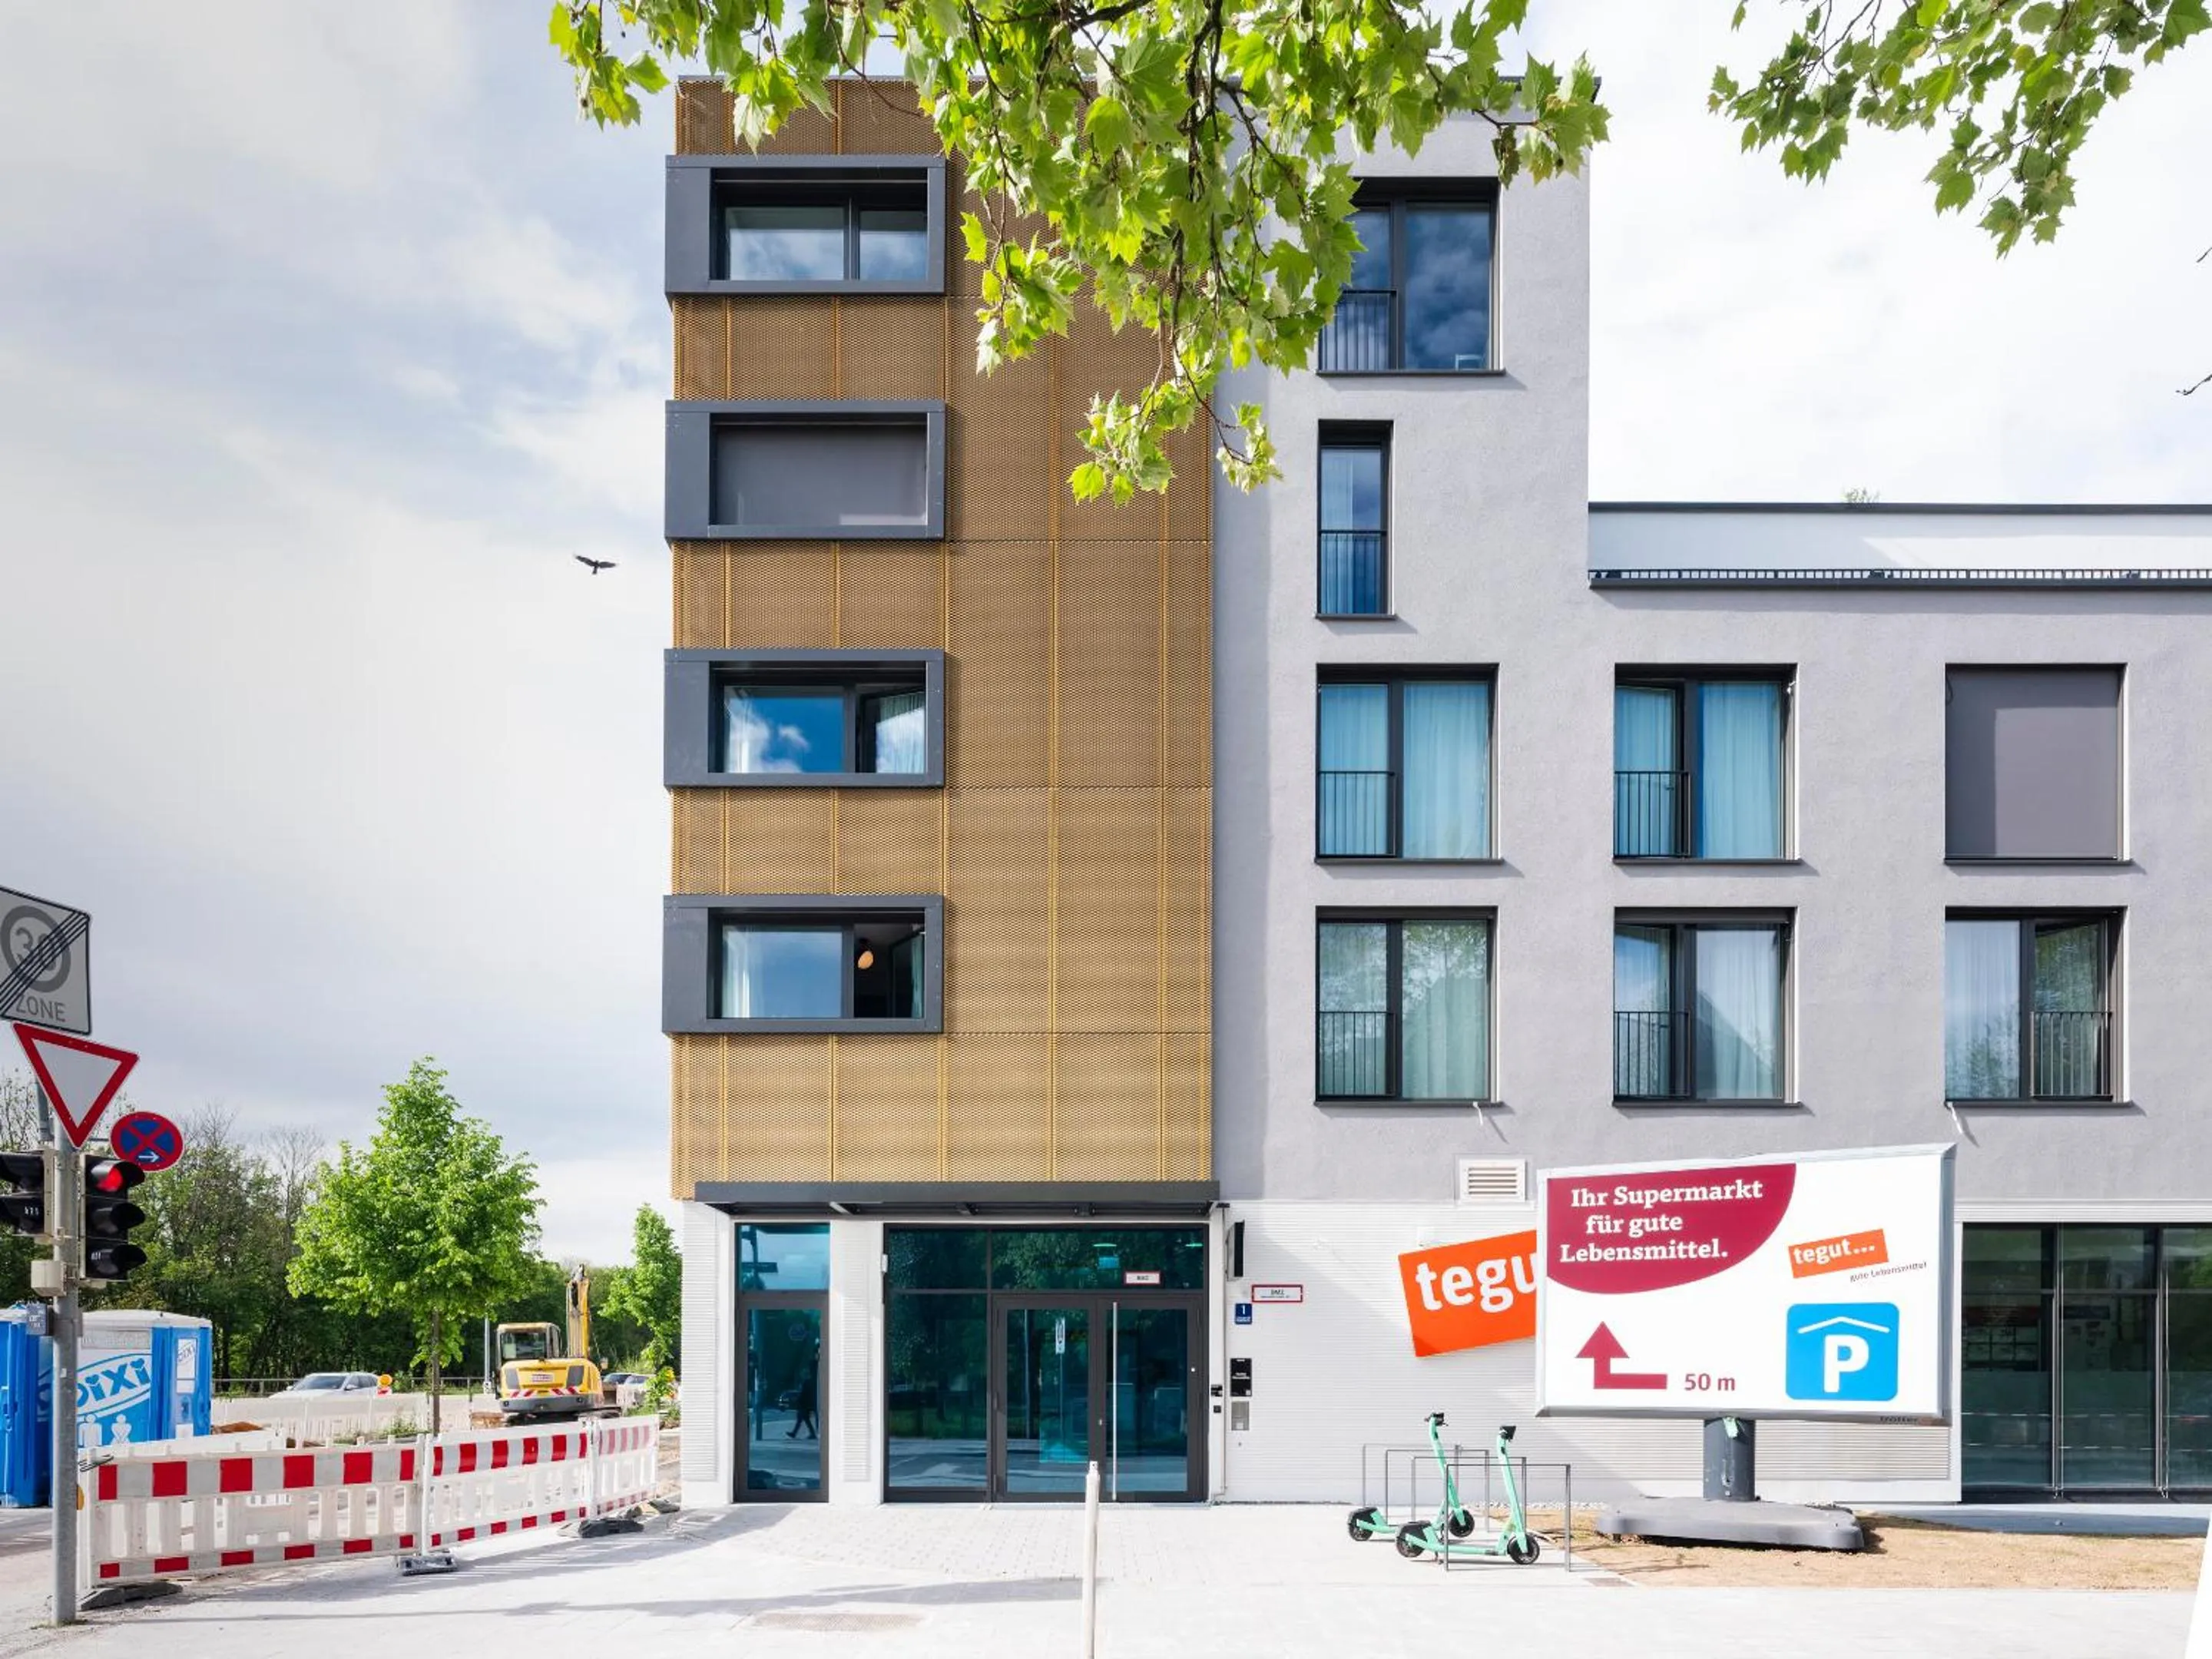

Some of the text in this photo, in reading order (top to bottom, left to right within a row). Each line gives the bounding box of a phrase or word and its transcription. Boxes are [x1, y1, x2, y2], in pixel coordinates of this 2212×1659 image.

[16, 994, 66, 1022] ZONE
[1571, 1180, 1763, 1209] Ihr Supermarkt
[1586, 1214, 1683, 1238] für gute
[1560, 1238, 1727, 1263] Lebensmittel.
[1793, 1238, 1875, 1265] tegut...
[1823, 1333, 1869, 1393] P
[1684, 1373, 1736, 1391] 50 m
